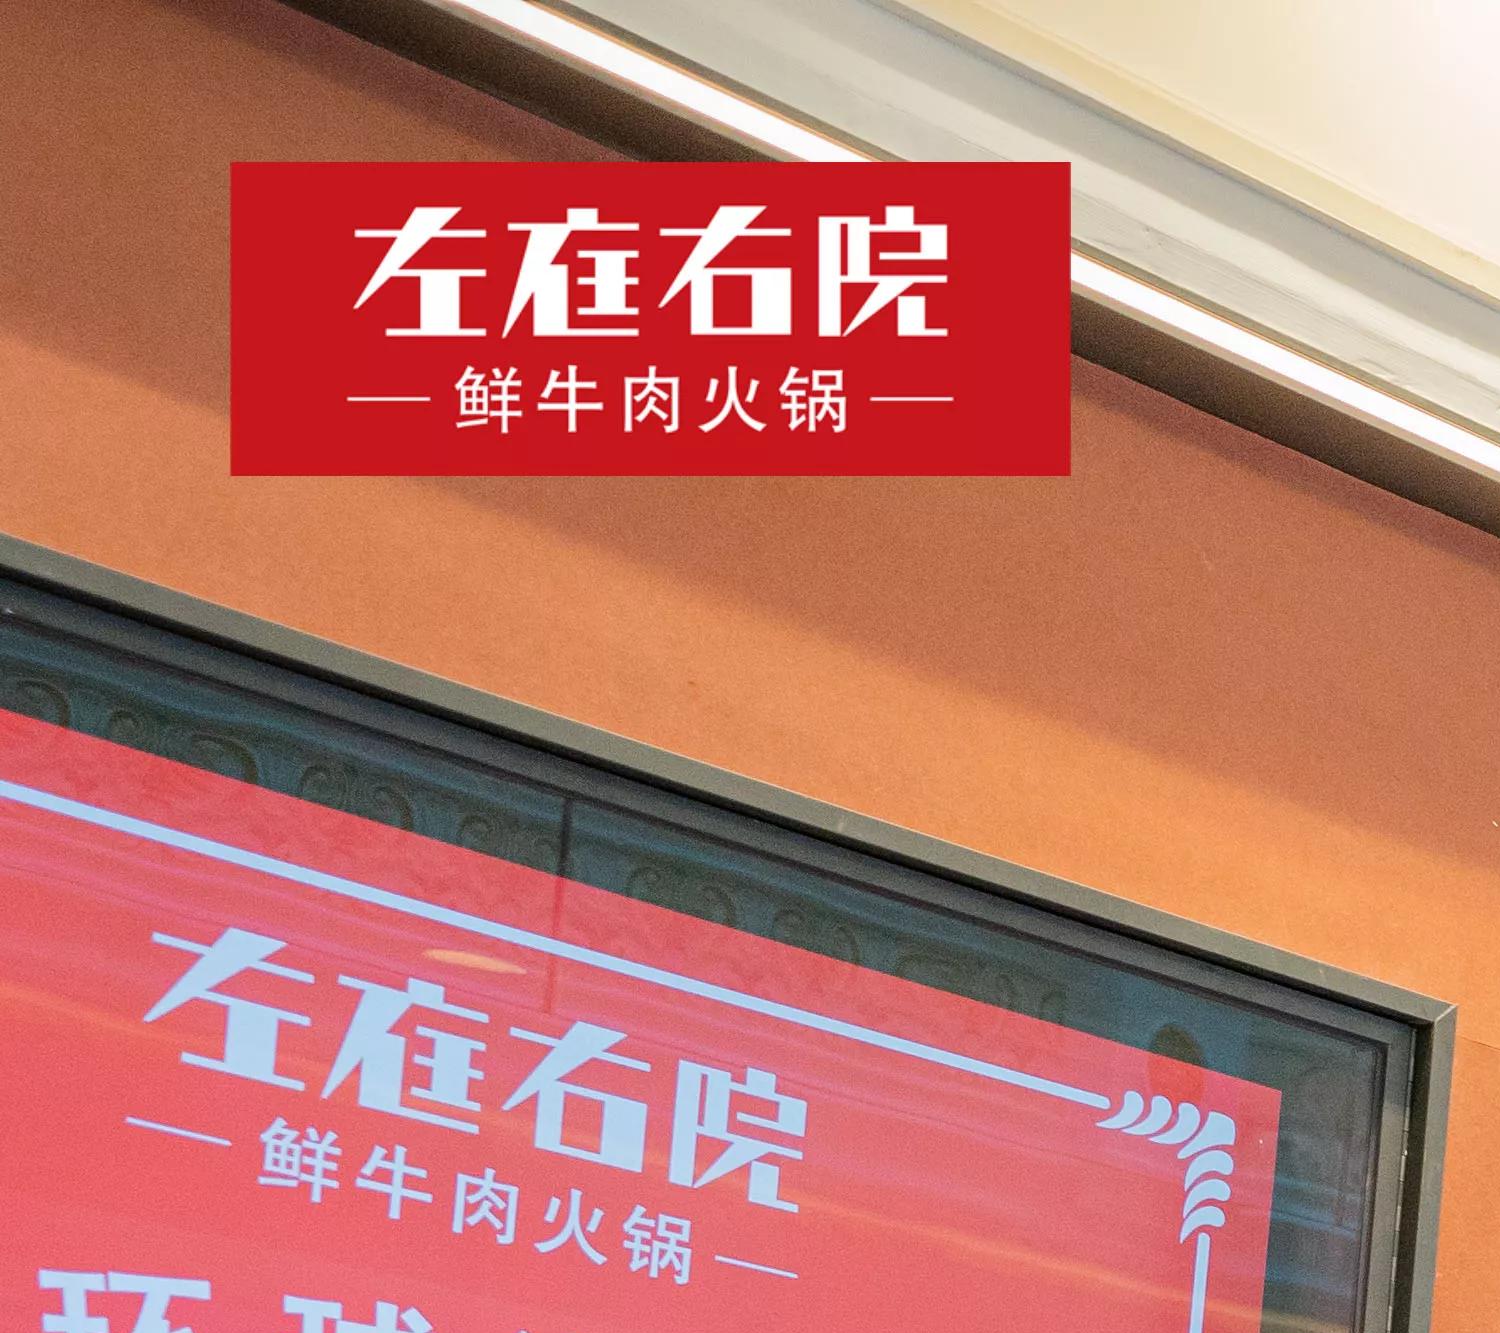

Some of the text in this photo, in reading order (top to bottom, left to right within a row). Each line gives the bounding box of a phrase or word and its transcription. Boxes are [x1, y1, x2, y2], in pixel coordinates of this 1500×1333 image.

[143, 927, 809, 1213] 左庭右院
[258, 1114, 695, 1286] 鲜牛肉火锅
